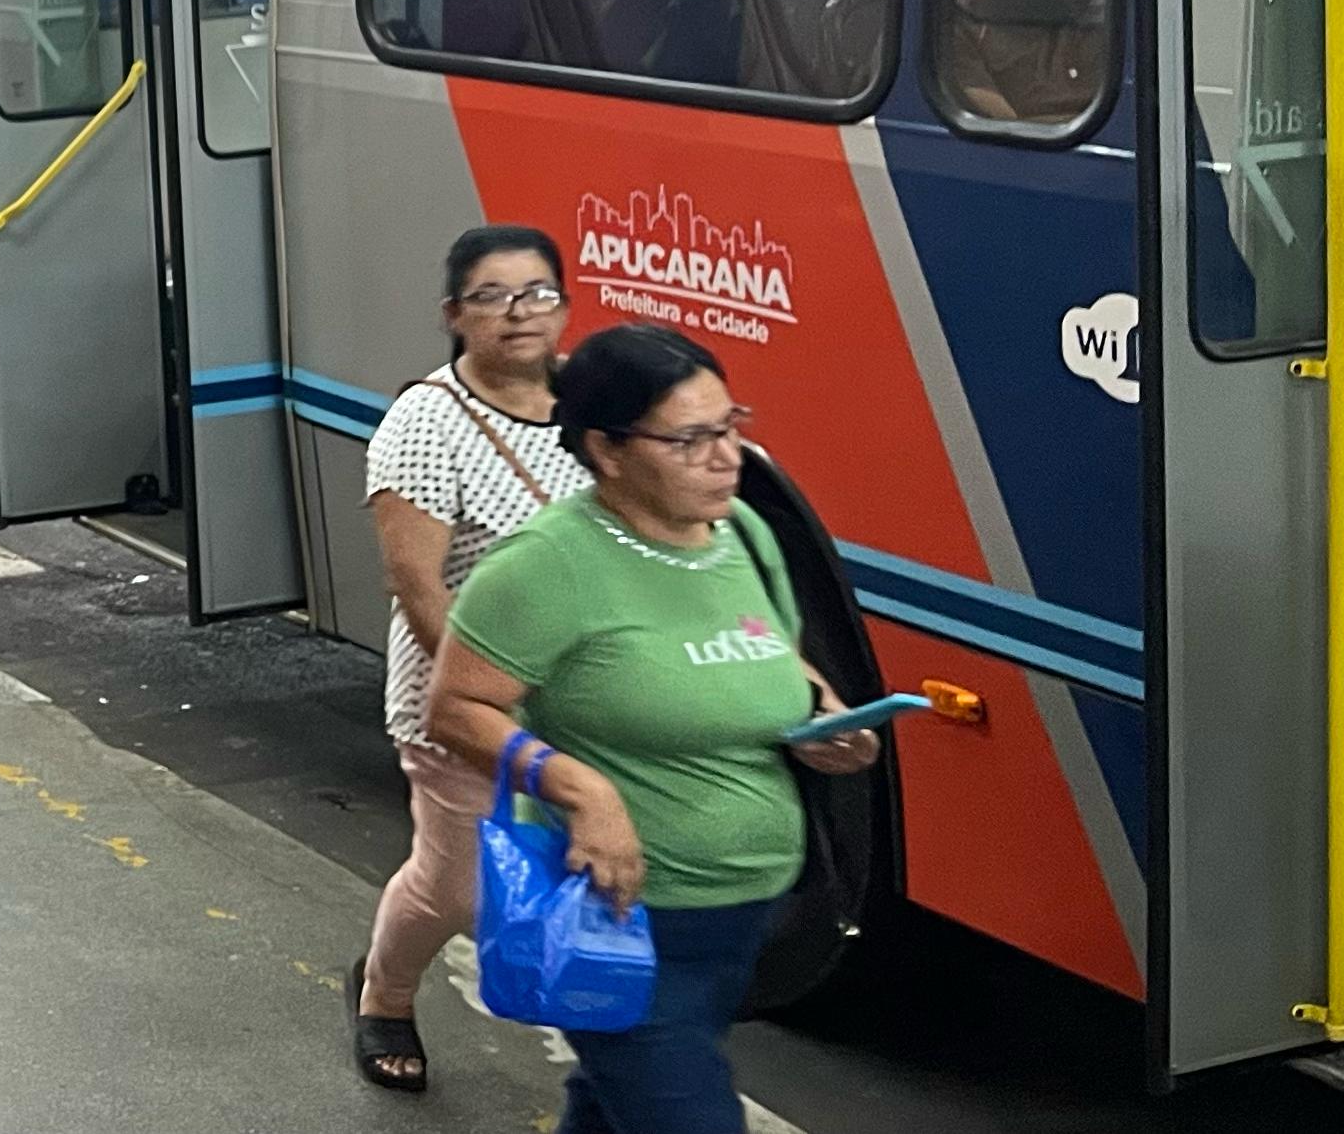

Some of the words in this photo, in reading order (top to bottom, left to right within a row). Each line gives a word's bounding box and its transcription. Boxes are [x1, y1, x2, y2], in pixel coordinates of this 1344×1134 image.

[579, 230, 792, 311] APUCARANA
[600, 284, 682, 323] Prefeitura
[703, 308, 769, 344] Cidade
